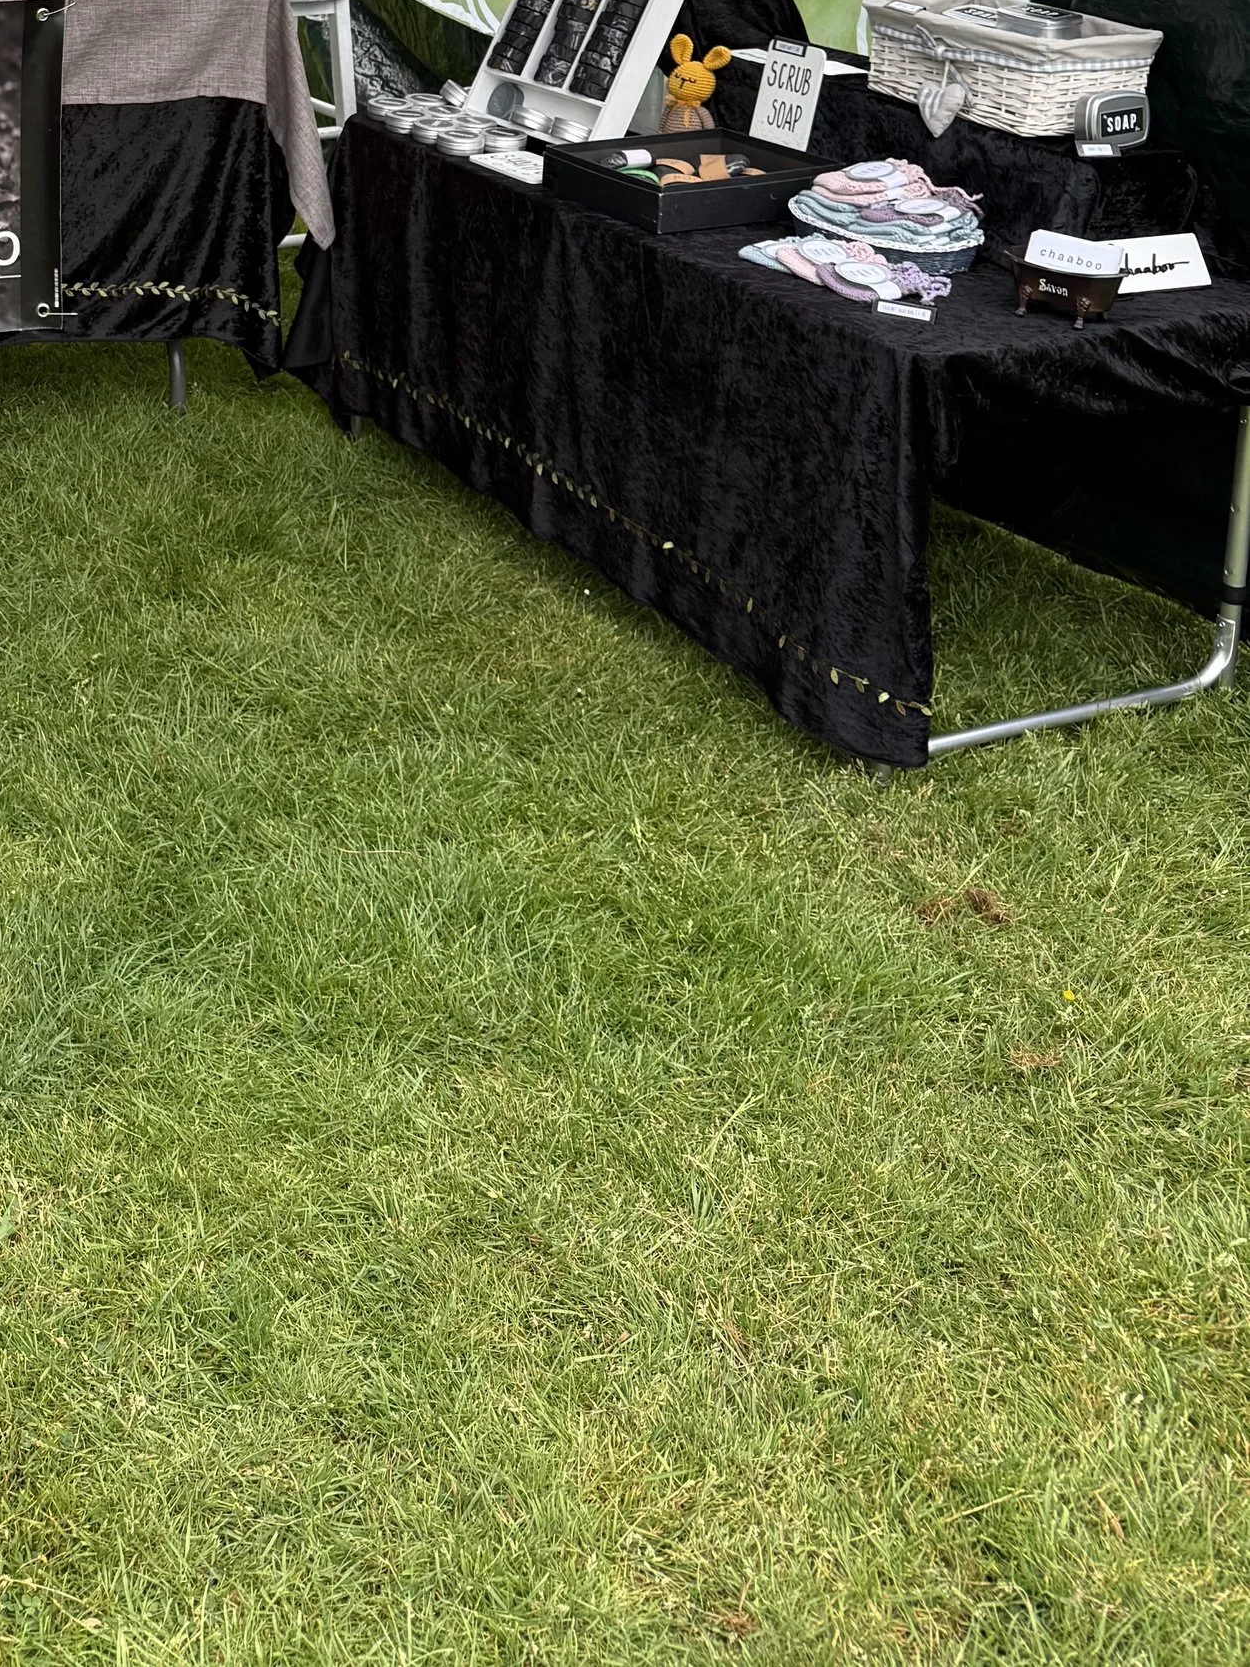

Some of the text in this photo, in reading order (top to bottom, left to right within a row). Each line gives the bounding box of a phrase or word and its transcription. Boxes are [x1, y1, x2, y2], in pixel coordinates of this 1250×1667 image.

[767, 60, 812, 96] SCRUB
[767, 98, 803, 133] SOAP
[1106, 113, 1137, 133] SOAP
[1040, 248, 1103, 271] chaaboo
[1038, 278, 1069, 298] Savon
